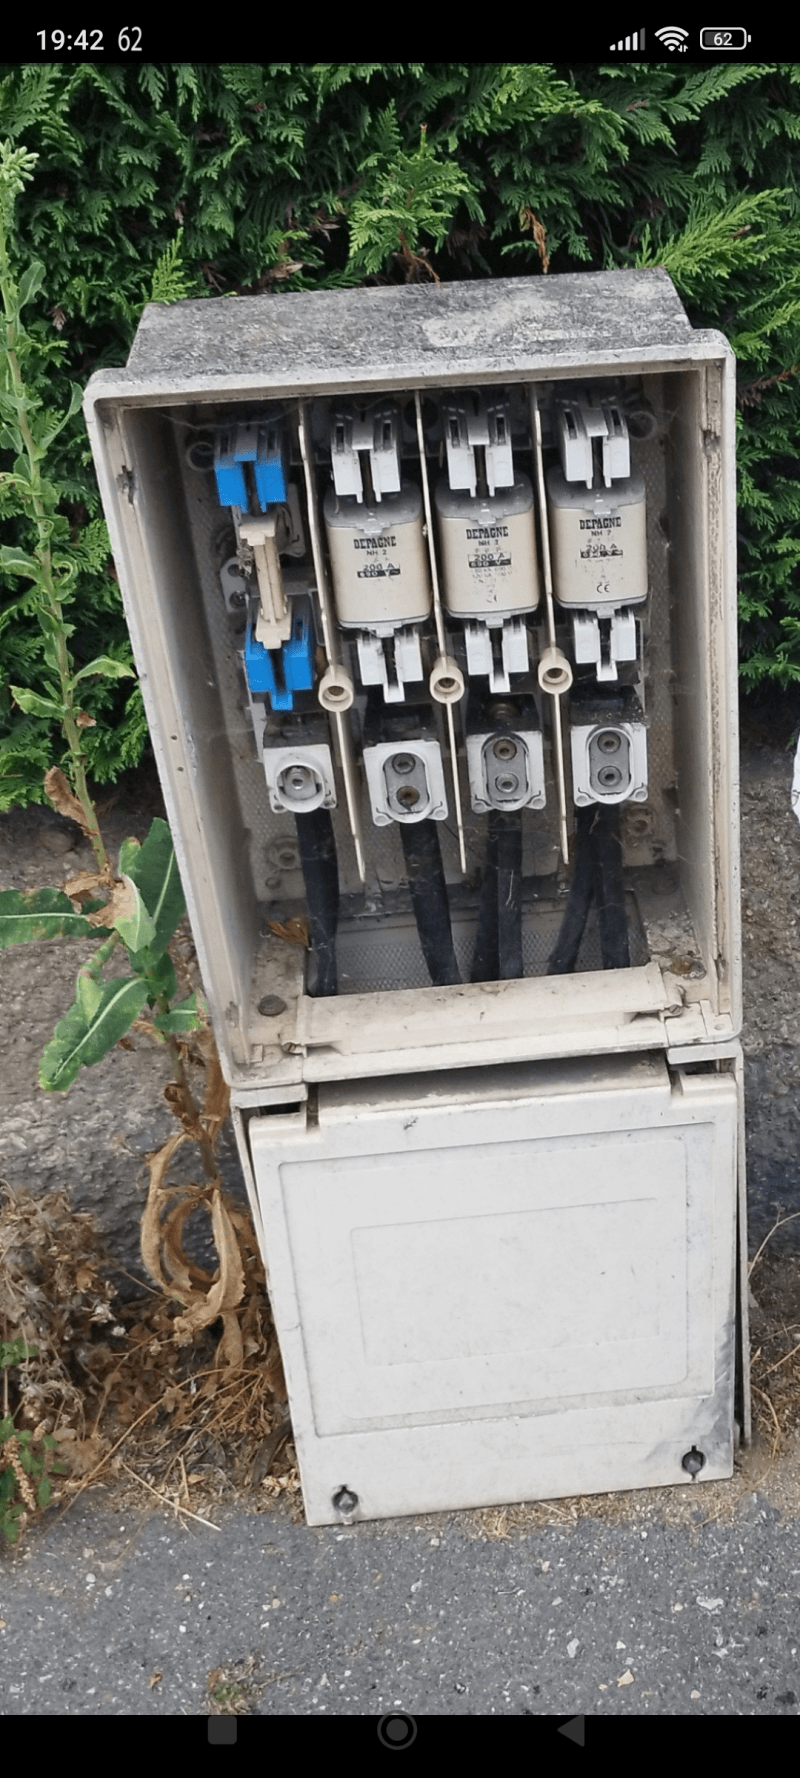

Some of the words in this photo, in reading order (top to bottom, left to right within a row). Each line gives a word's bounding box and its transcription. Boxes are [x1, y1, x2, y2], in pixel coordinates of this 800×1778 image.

[579, 516, 621, 530] DEPAGNE
[466, 526, 509, 540] DEPAGNE
[353, 536, 397, 550] DEPAGNE
[382, 548, 387, 556] 2
[474, 553, 494, 562] 200
[363, 562, 383, 572] 200
